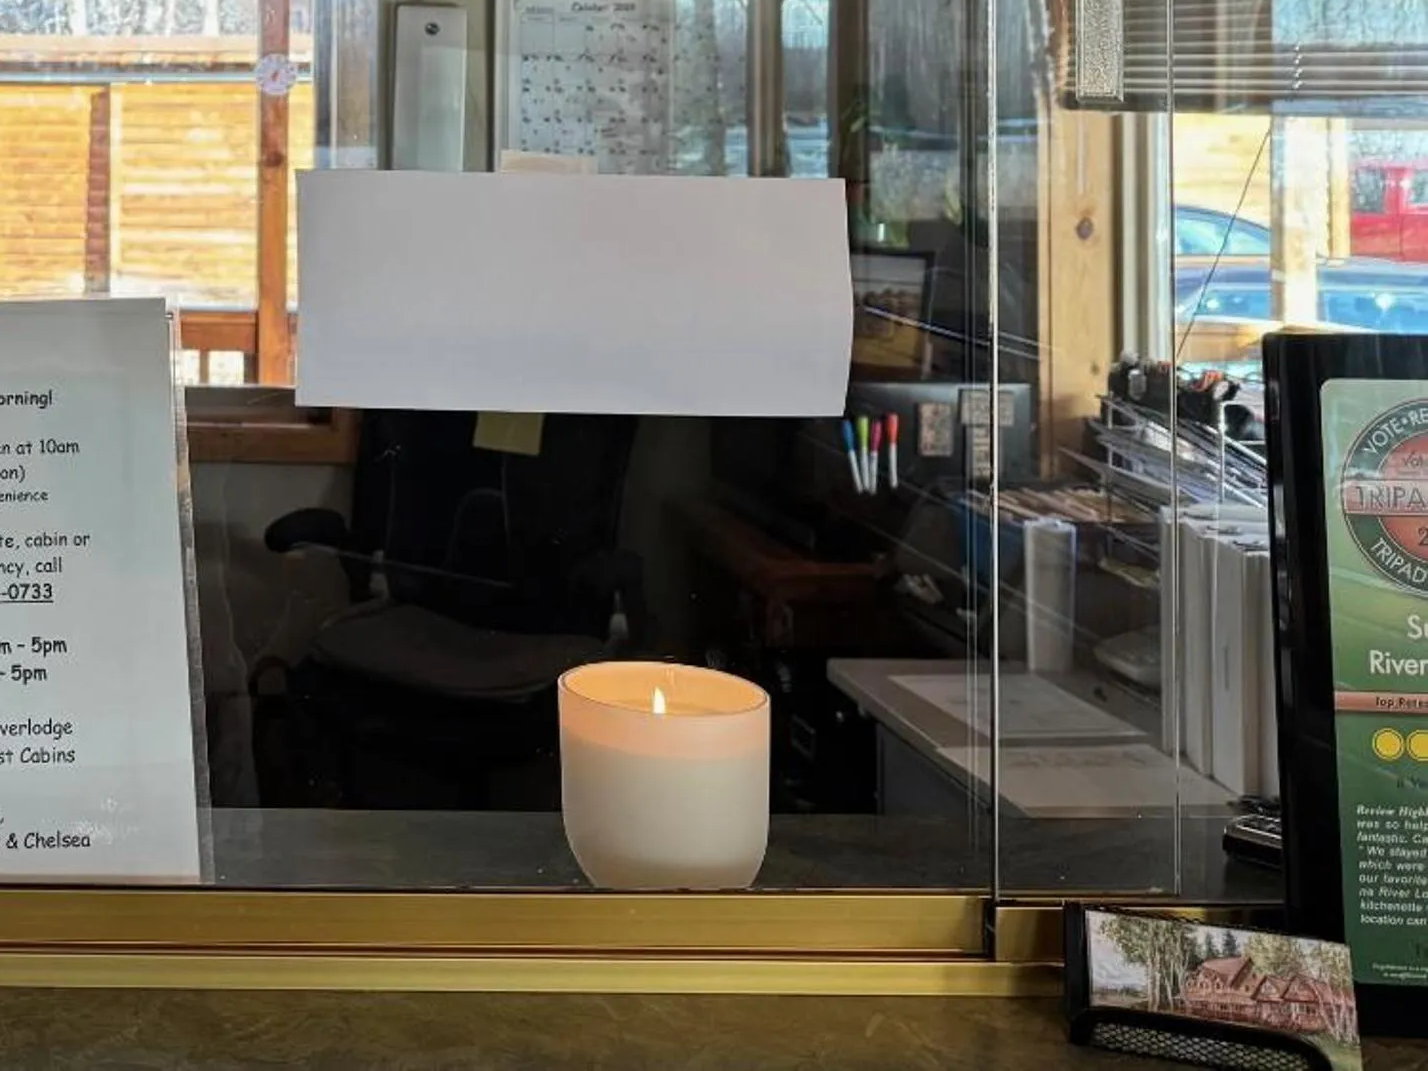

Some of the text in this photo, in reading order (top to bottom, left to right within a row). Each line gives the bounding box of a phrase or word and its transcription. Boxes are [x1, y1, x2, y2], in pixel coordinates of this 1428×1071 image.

[1362, 417, 1404, 455] VOTE
[15, 441, 35, 457] at
[39, 438, 80, 455] 10am
[24, 531, 71, 550] cabin
[73, 533, 90, 549] or
[34, 556, 62, 573] call
[31, 635, 68, 657] 5pm
[1369, 649, 1428, 676] River
[11, 664, 48, 684] 5pm
[19, 745, 76, 766] Cabins
[5, 833, 20, 850] &
[23, 830, 92, 849] Chelsea
